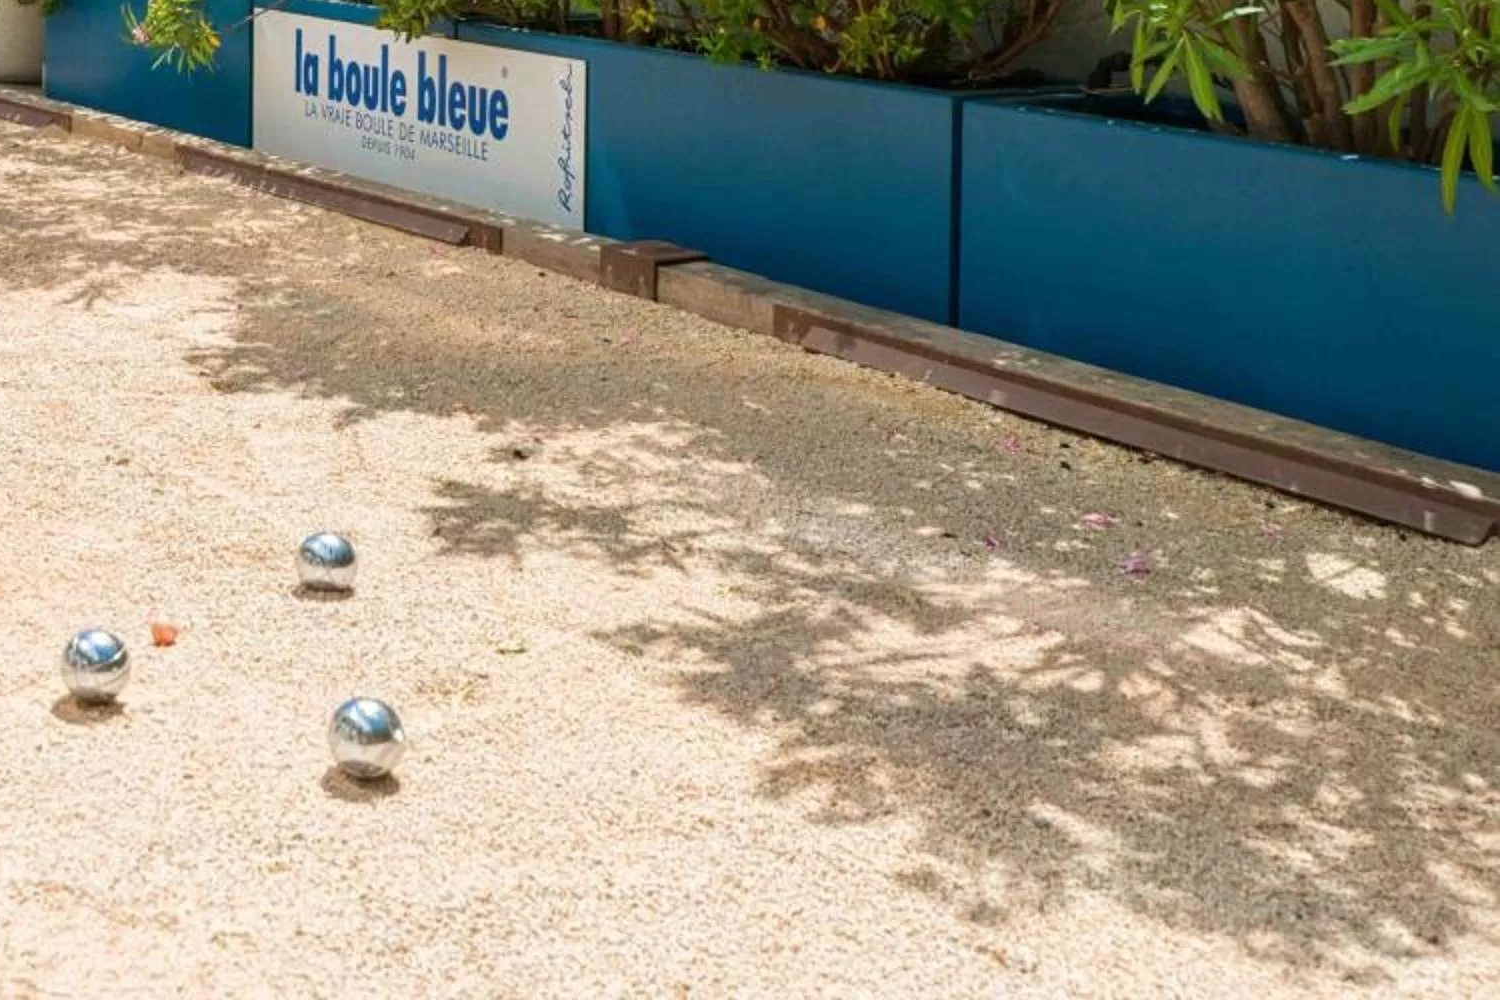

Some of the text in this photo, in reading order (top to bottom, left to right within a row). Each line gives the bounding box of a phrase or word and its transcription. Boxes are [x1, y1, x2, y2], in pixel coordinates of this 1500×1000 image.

[295, 28, 509, 140] la boule bleue
[304, 100, 490, 161] LA VRAIE BOULE DE MARSEILLE
